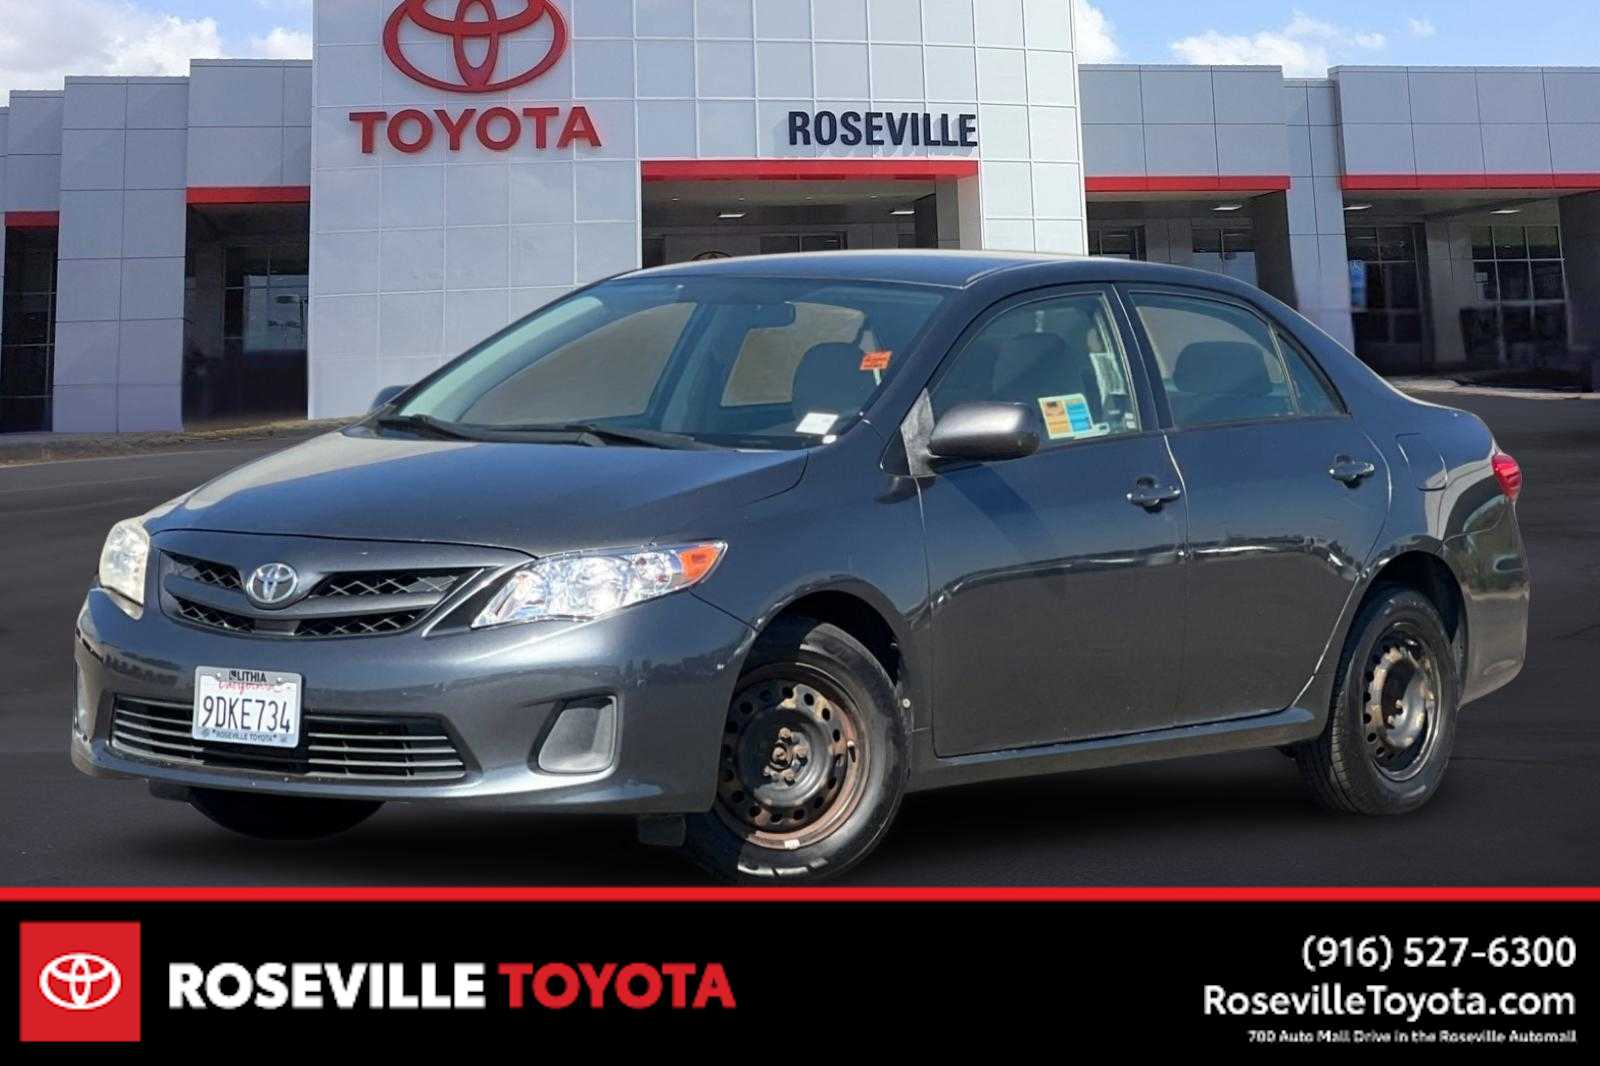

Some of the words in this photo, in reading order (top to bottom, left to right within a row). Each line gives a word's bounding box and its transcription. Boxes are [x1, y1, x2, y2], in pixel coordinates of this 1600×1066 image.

[349, 106, 602, 154] TOYOTA
[789, 111, 978, 147] ROSEVILLE
[237, 671, 266, 683] LITHIA
[201, 695, 290, 733] 9DKE734
